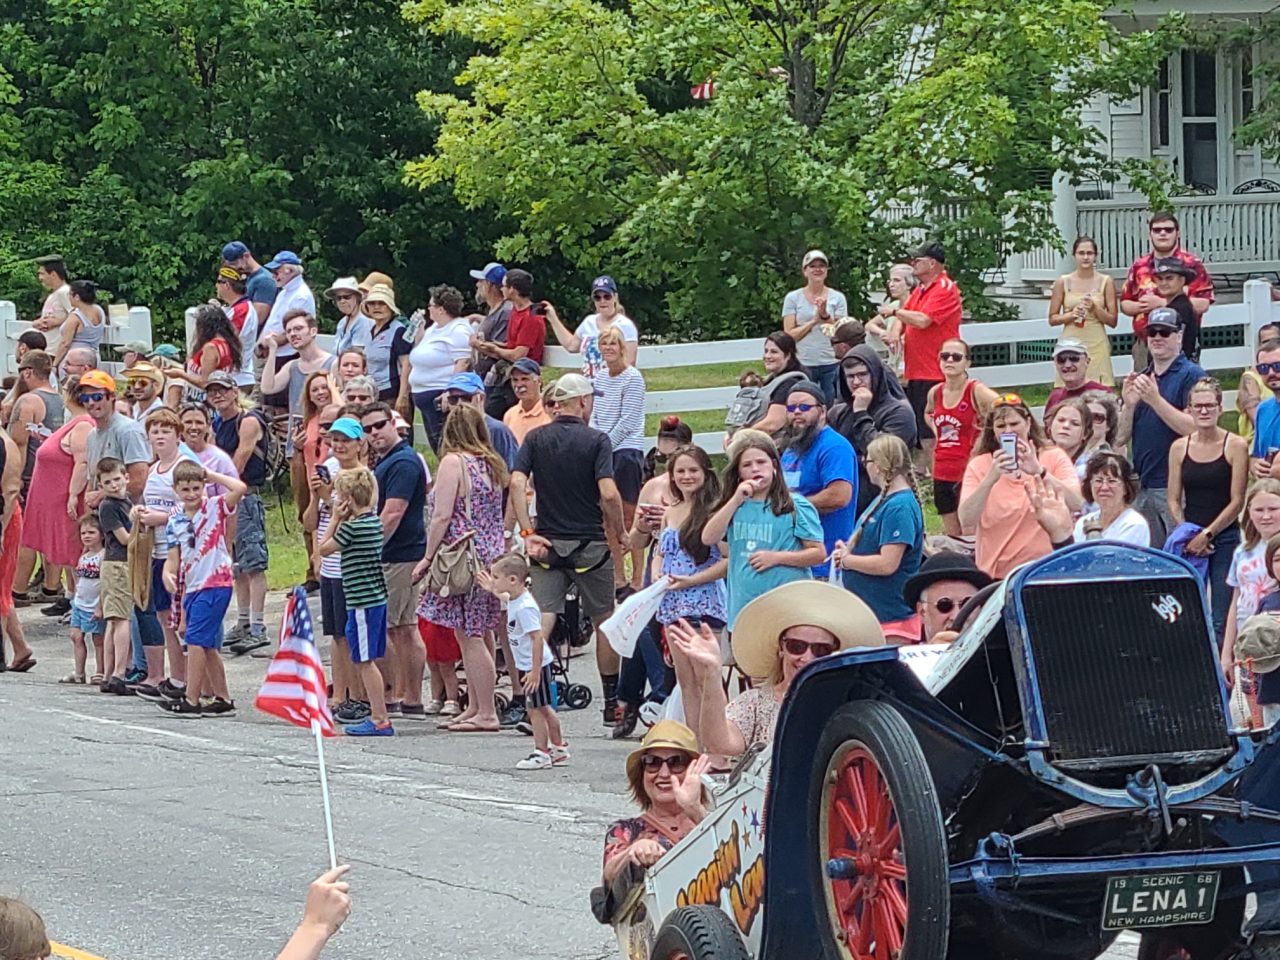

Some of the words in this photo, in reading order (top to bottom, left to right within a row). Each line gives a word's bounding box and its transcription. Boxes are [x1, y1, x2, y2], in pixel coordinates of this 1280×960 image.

[733, 521, 773, 543] HAWAII
[1151, 595, 1182, 623] 1919
[1114, 880, 1126, 888] 19
[1142, 875, 1184, 887] SCENIC
[1197, 875, 1212, 883] 68
[729, 853, 765, 937] Len
[1112, 888, 1187, 914] LENA
[1197, 887, 1206, 907] 1
[1108, 918, 1135, 927] NEW
[1140, 911, 1207, 924] HAMPSHIRE
